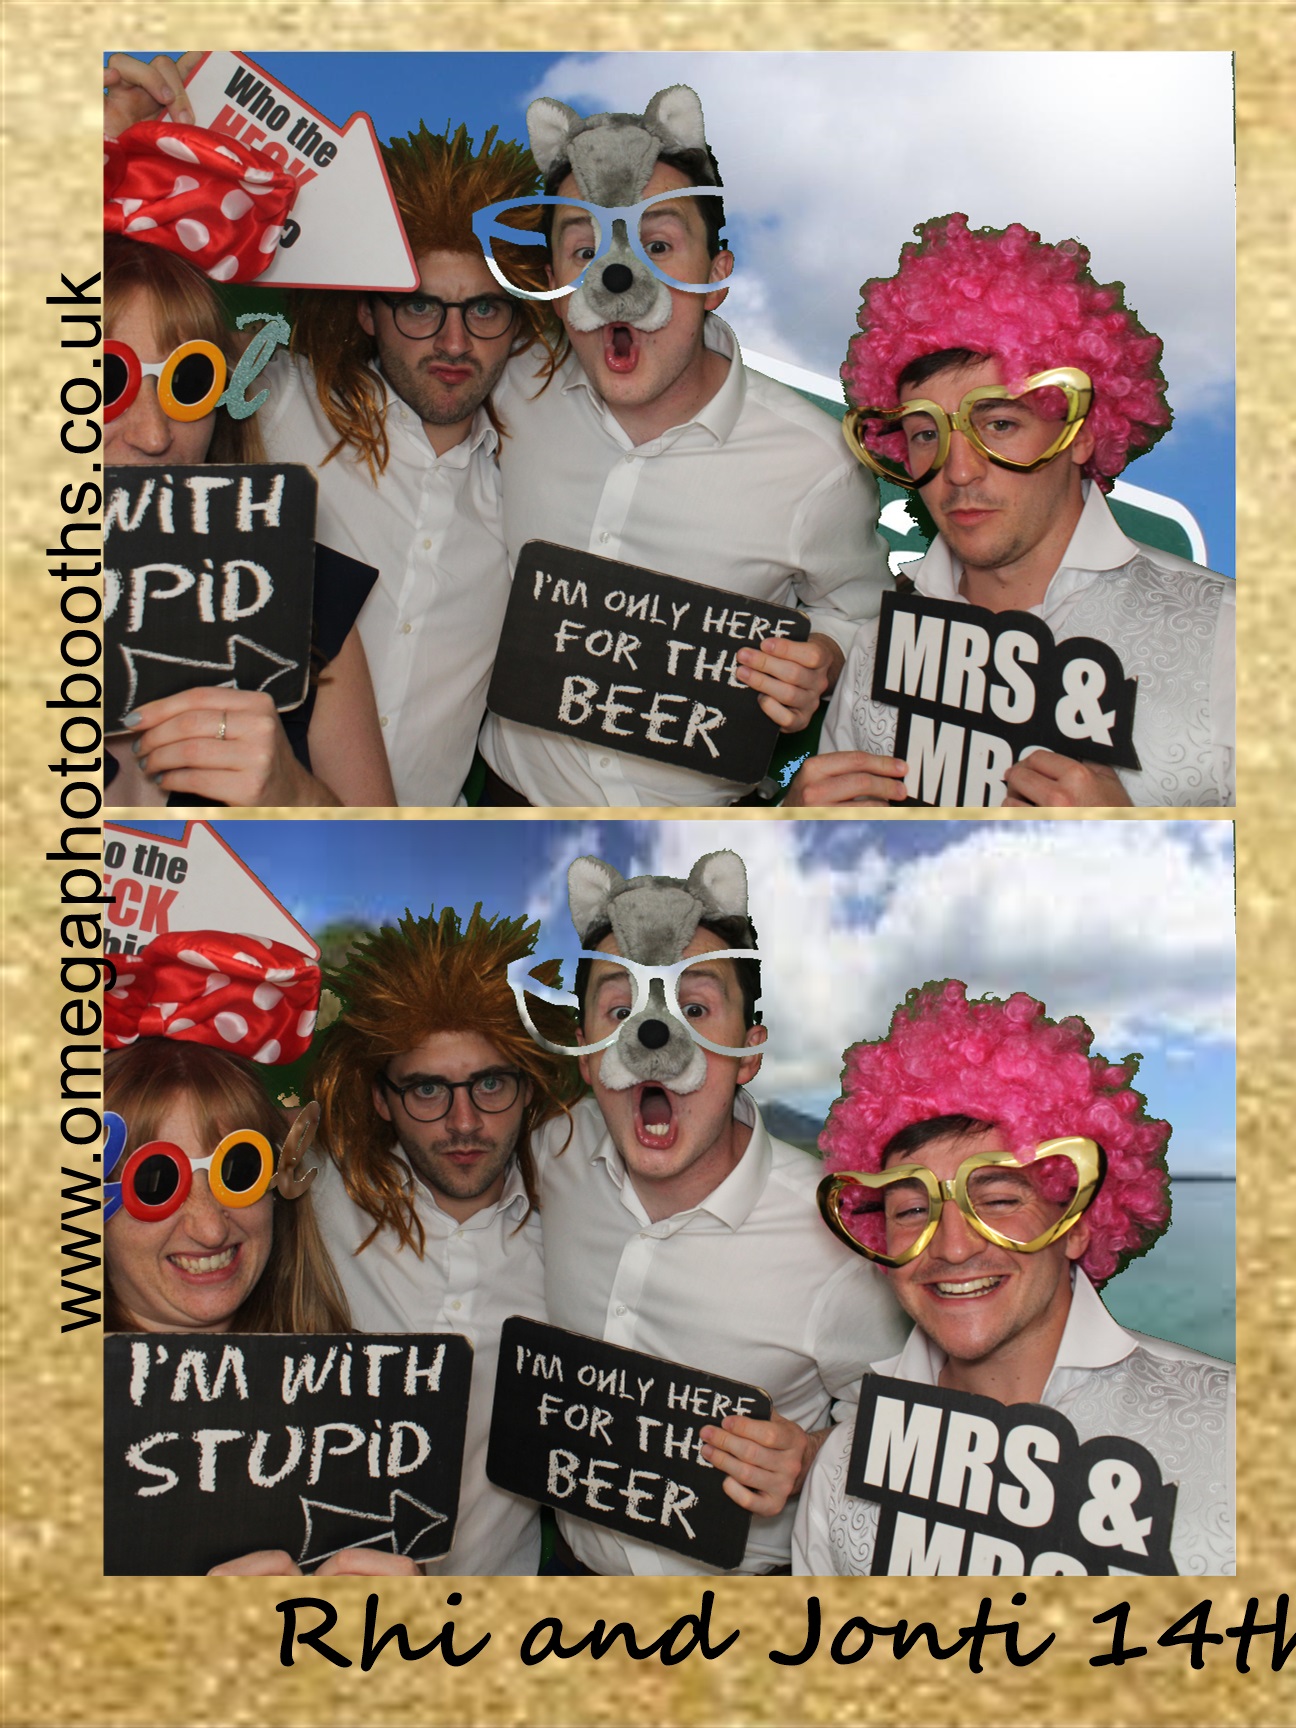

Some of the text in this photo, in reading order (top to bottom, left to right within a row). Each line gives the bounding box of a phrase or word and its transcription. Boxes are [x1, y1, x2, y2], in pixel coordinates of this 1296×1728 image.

[224, 65, 338, 168] Who the
[533, 570, 796, 641] I'M ONLY HERE
[554, 619, 642, 670] FOR
[558, 674, 728, 759] BEER
[884, 609, 1116, 747] MRS &
[903, 713, 1055, 807] MR
[132, 843, 188, 884] the
[129, 1342, 249, 1407] I'M
[516, 1345, 756, 1418] I'M ONLY HERE
[537, 1393, 614, 1446] FOR
[547, 1448, 699, 1539] BEER
[863, 1395, 1060, 1528] MRS
[1078, 1458, 1153, 1557] &
